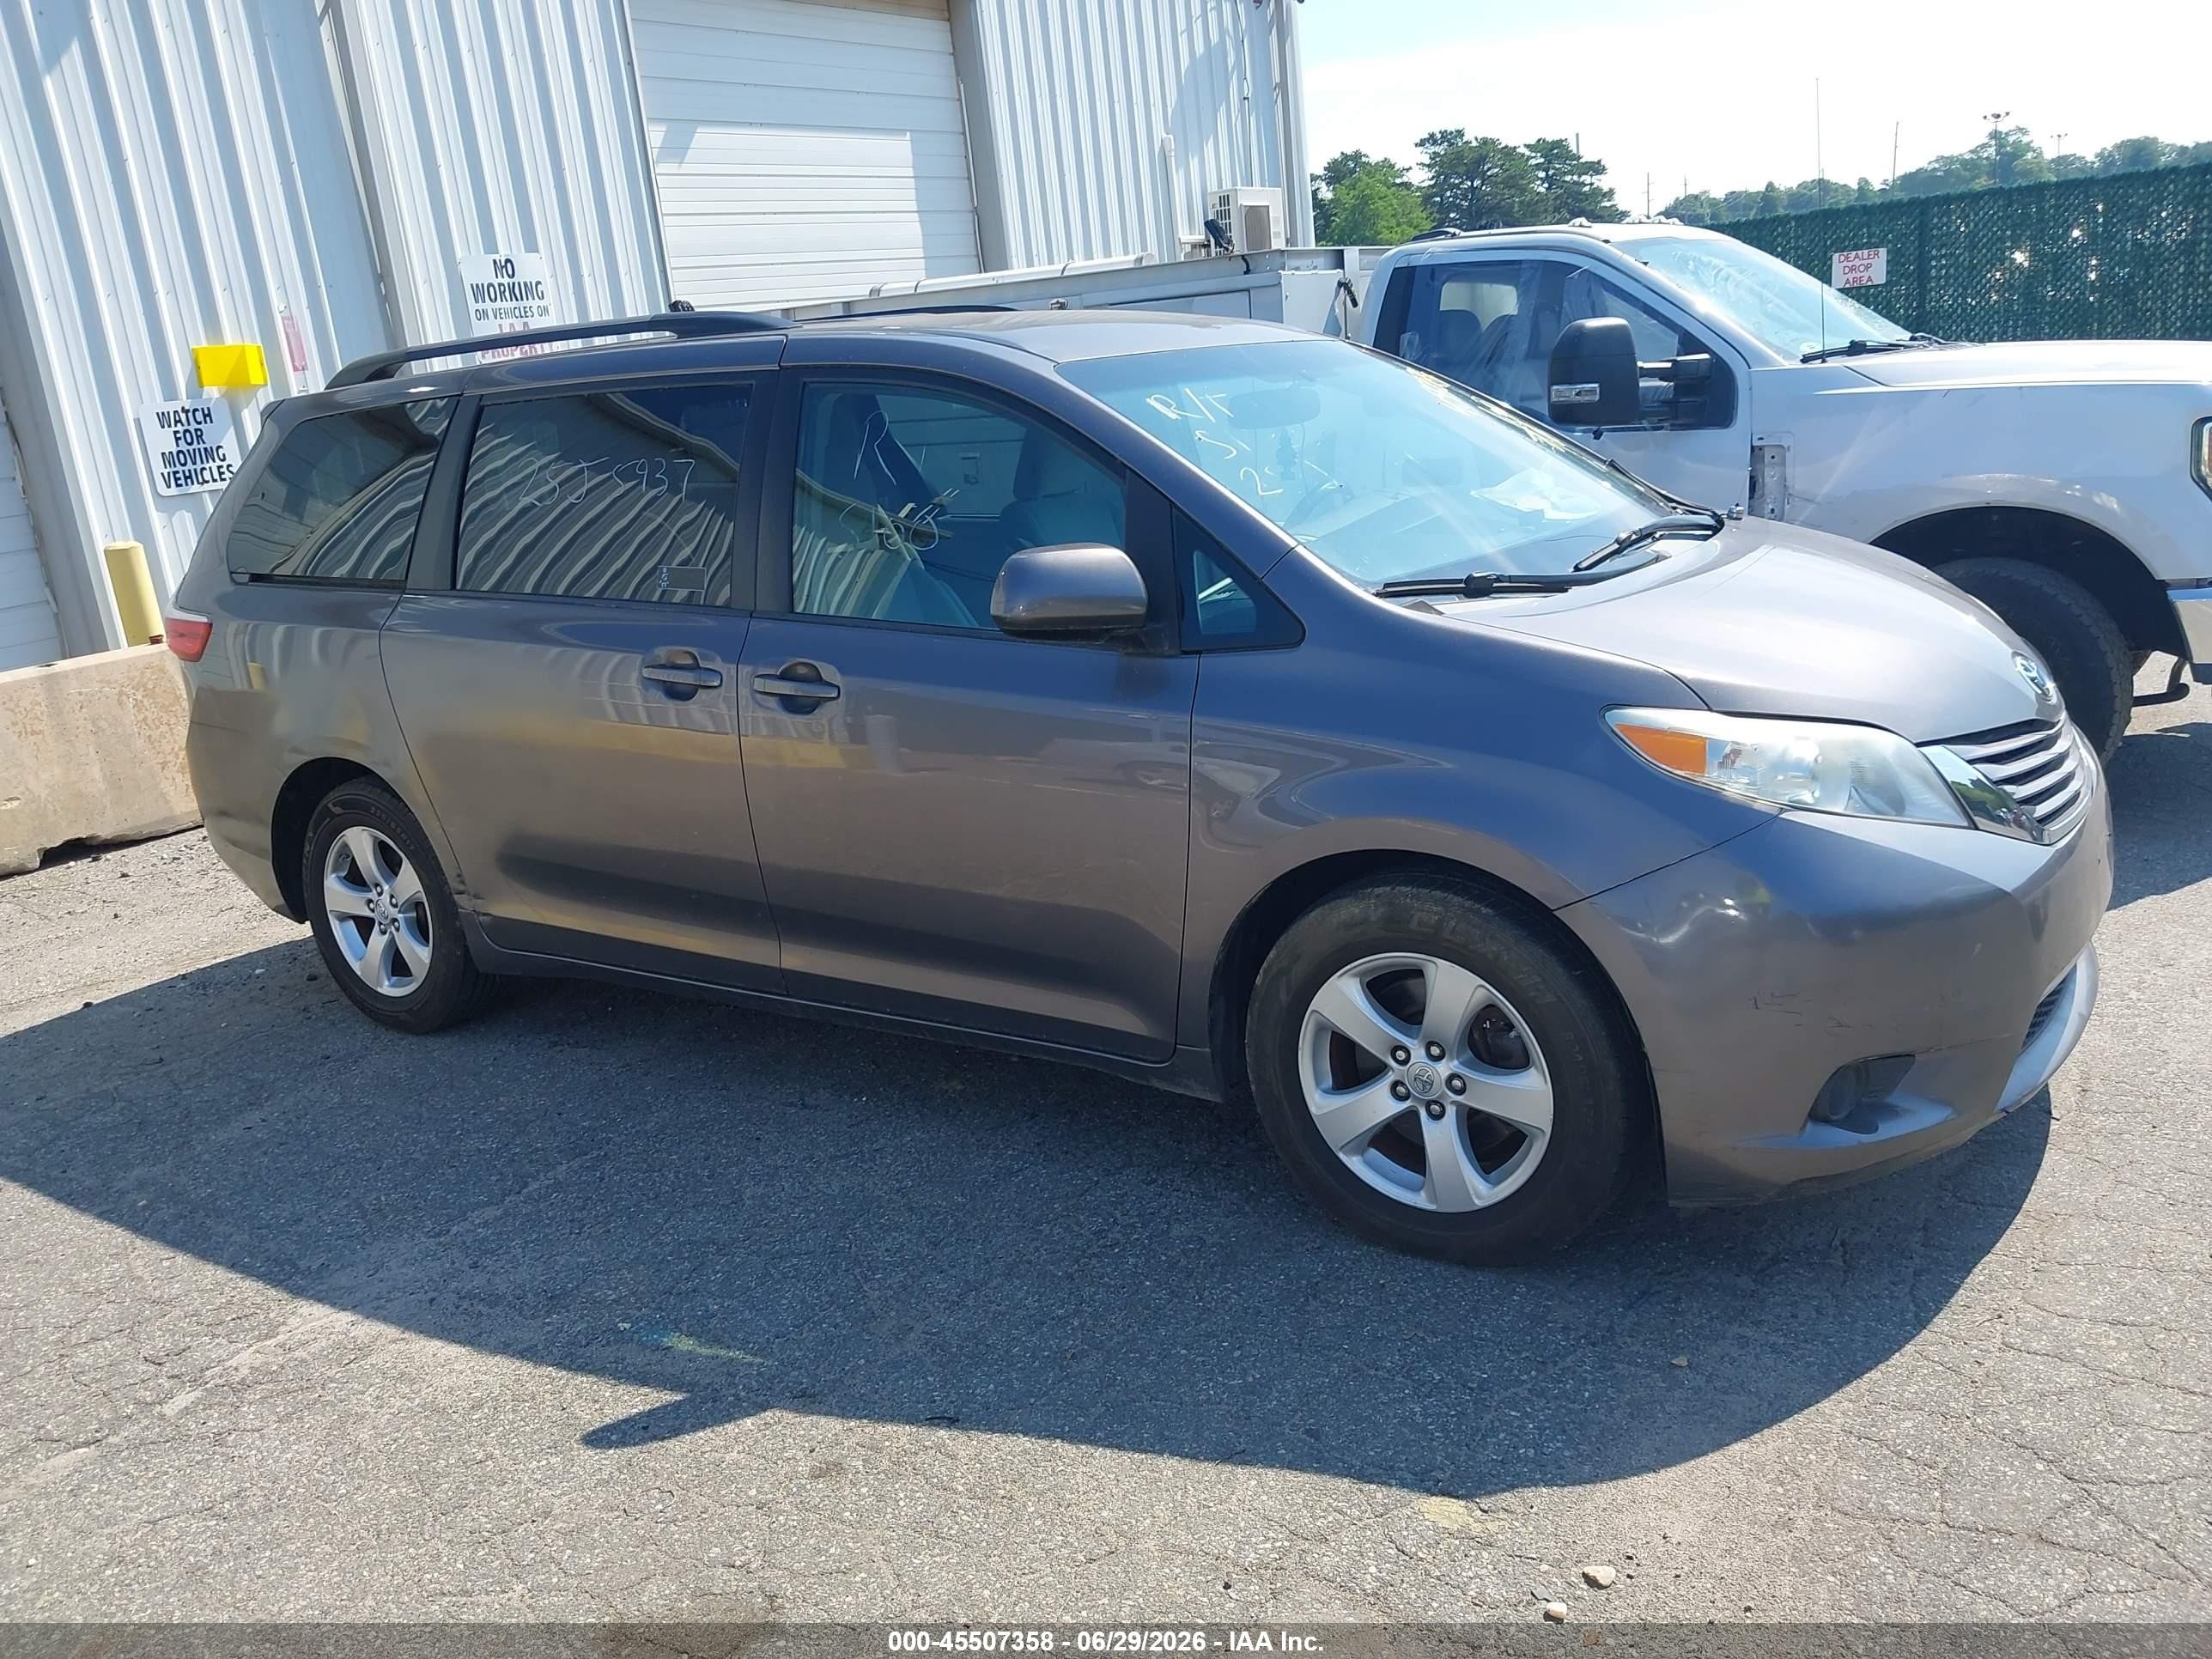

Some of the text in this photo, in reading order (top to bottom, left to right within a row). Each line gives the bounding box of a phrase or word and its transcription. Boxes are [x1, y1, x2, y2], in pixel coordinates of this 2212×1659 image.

[1838, 249, 1880, 264] DEALER
[492, 257, 515, 279] NO
[1843, 263, 1873, 276] DROP
[470, 280, 545, 304] WORKING
[1843, 275, 1874, 288] AREA
[474, 304, 550, 321] ON VEHICLES ON
[155, 406, 214, 429] WATCH
[173, 428, 206, 448] FOR
[160, 445, 227, 470] MOVING
[161, 464, 235, 489] VEHICLES
